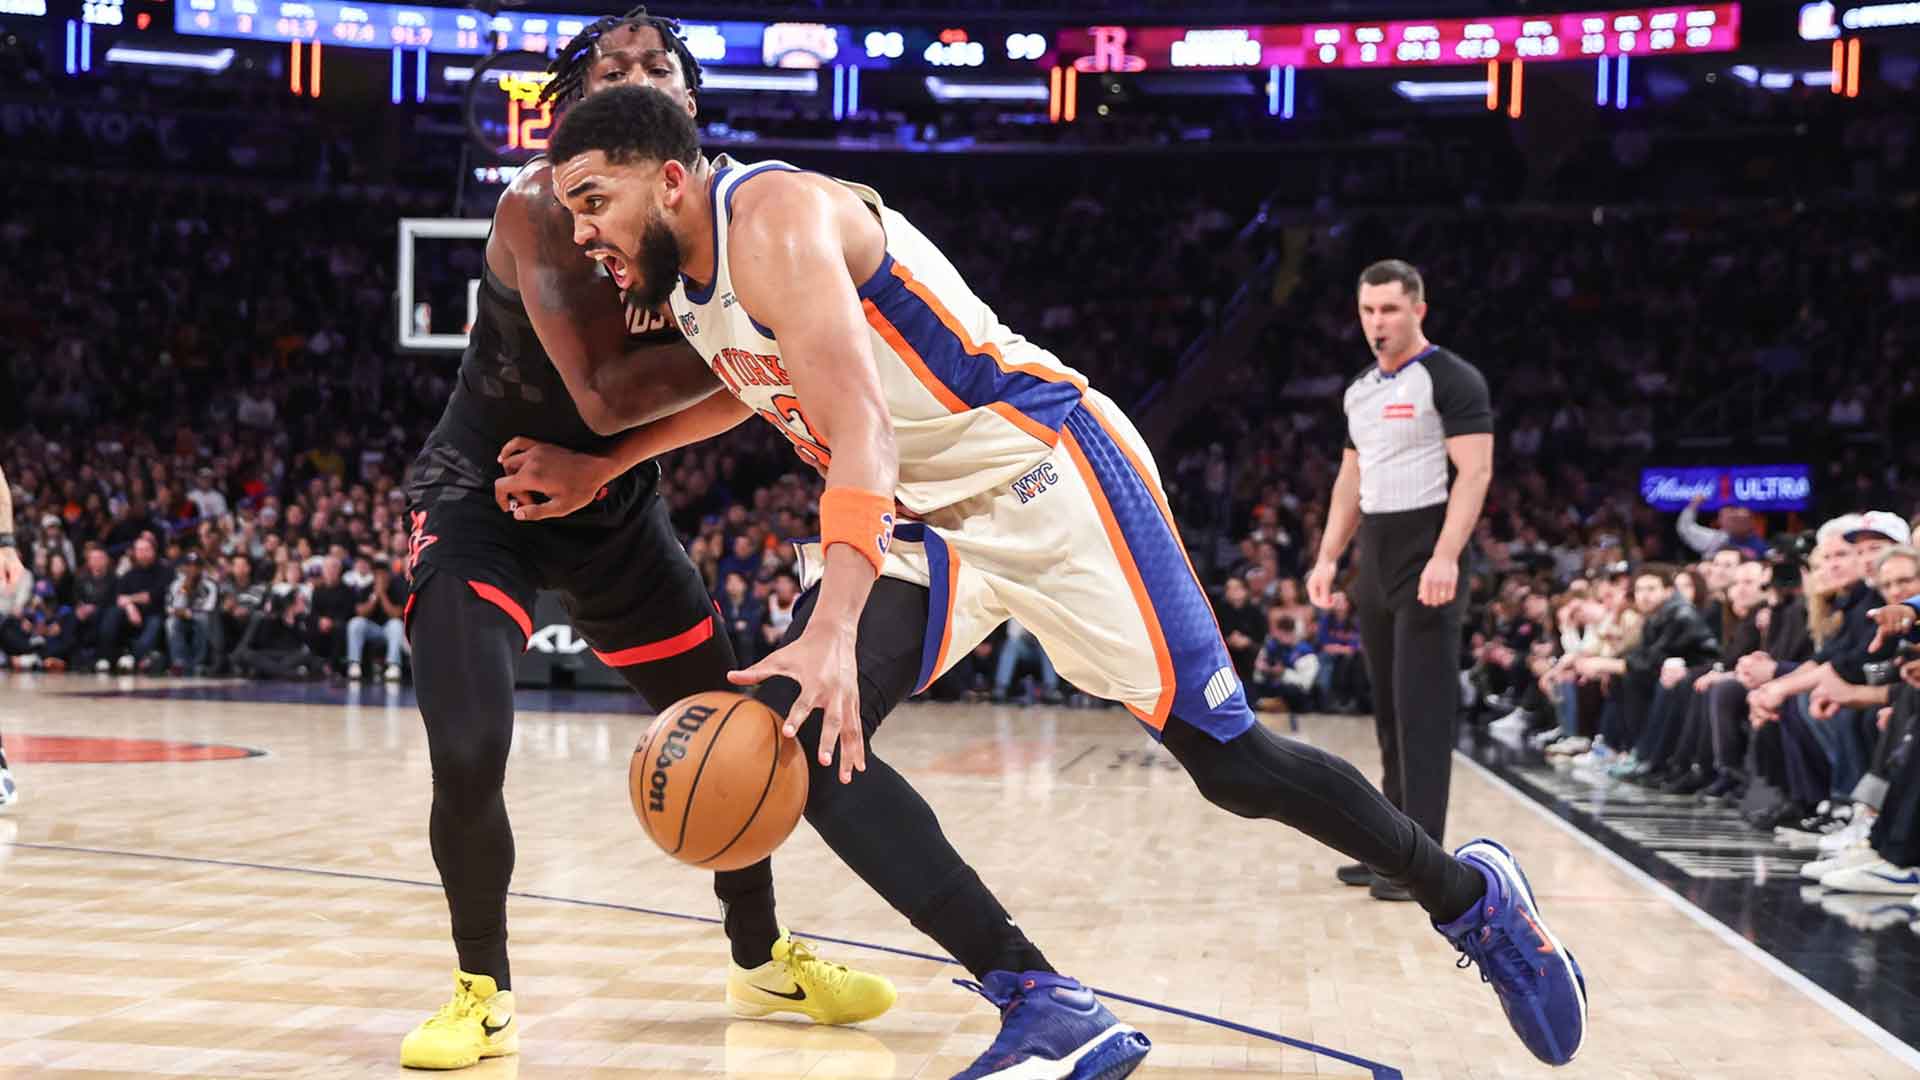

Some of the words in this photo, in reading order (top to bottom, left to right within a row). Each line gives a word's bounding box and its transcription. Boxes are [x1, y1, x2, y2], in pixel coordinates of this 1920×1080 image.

[508, 100, 552, 150] 12
[1012, 462, 1058, 504] NYC
[1734, 476, 1810, 500] ULTRA
[649, 705, 718, 813] Wilson
